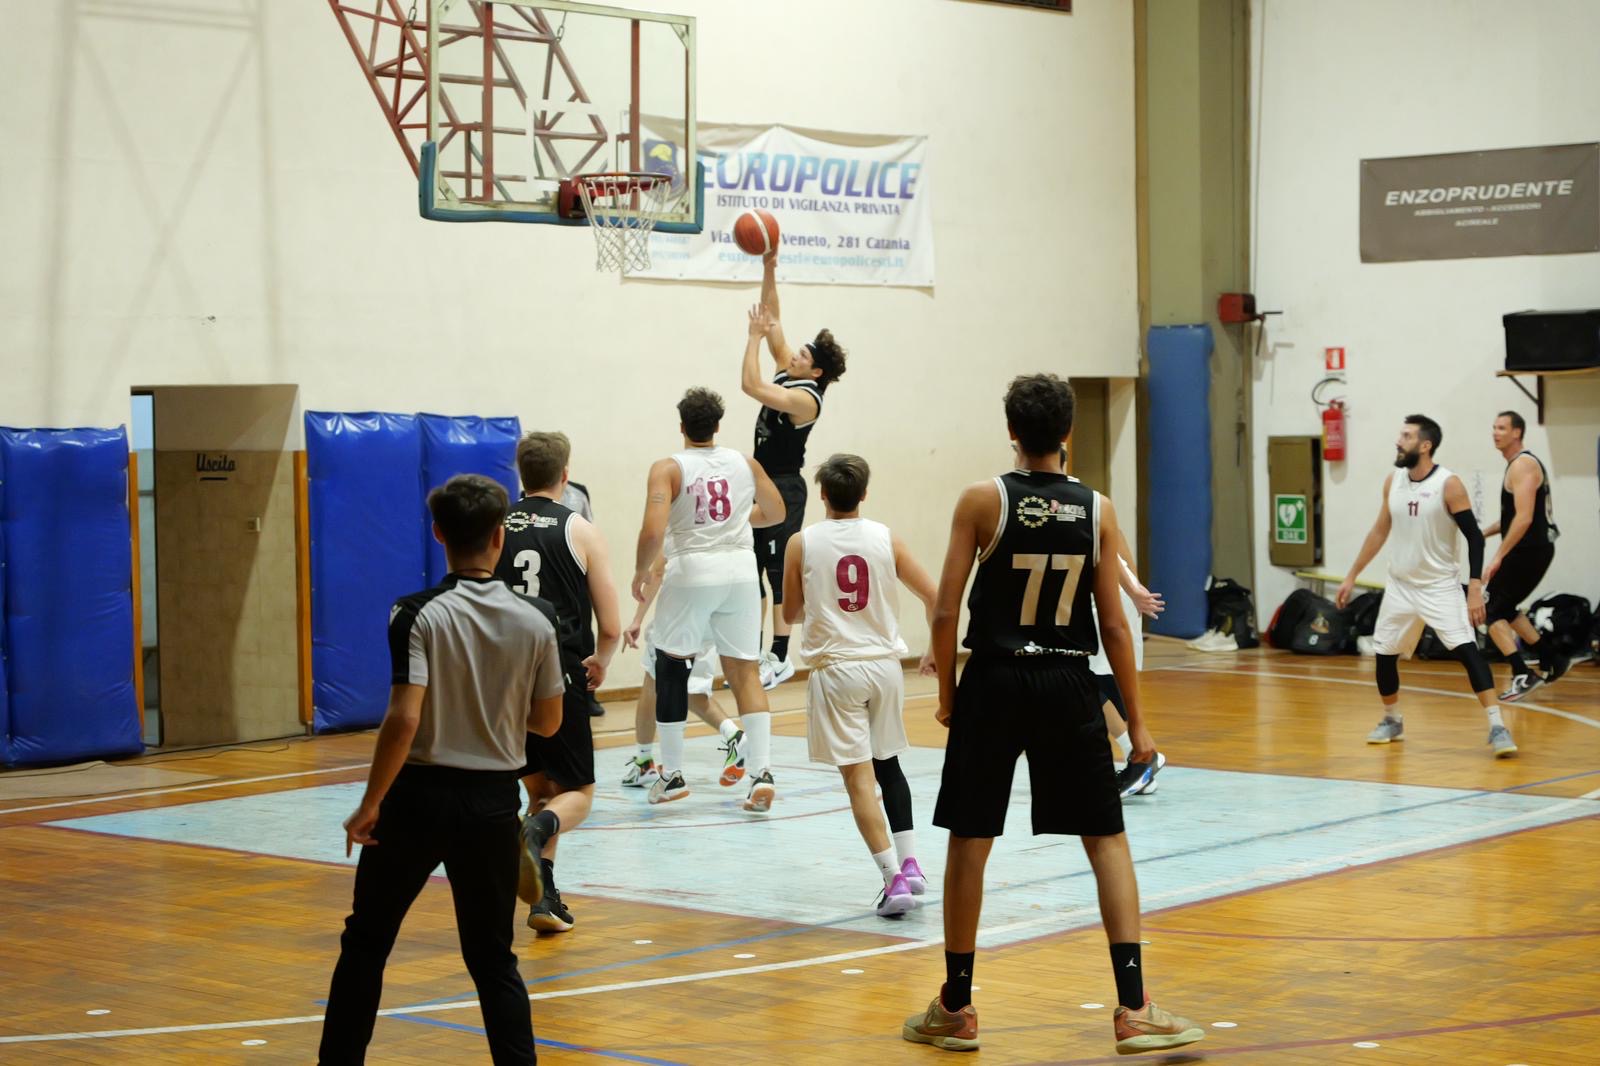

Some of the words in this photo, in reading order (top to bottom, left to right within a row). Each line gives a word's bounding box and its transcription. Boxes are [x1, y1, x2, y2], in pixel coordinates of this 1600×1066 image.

[717, 194, 768, 209] ISTITUTO
[772, 197, 785, 210] DI
[789, 197, 850, 213] VIGILANZA
[854, 203, 900, 216] PRIVATA
[1385, 179, 1574, 206] ENZOPRUDENTE
[782, 233, 831, 249] Veneto,
[838, 236, 860, 248] 281
[866, 237, 910, 250] Catania
[687, 477, 731, 525] 18
[1408, 501, 1419, 516] 11
[513, 549, 541, 598] 3
[836, 554, 869, 612] 9
[1012, 554, 1086, 626] 77
